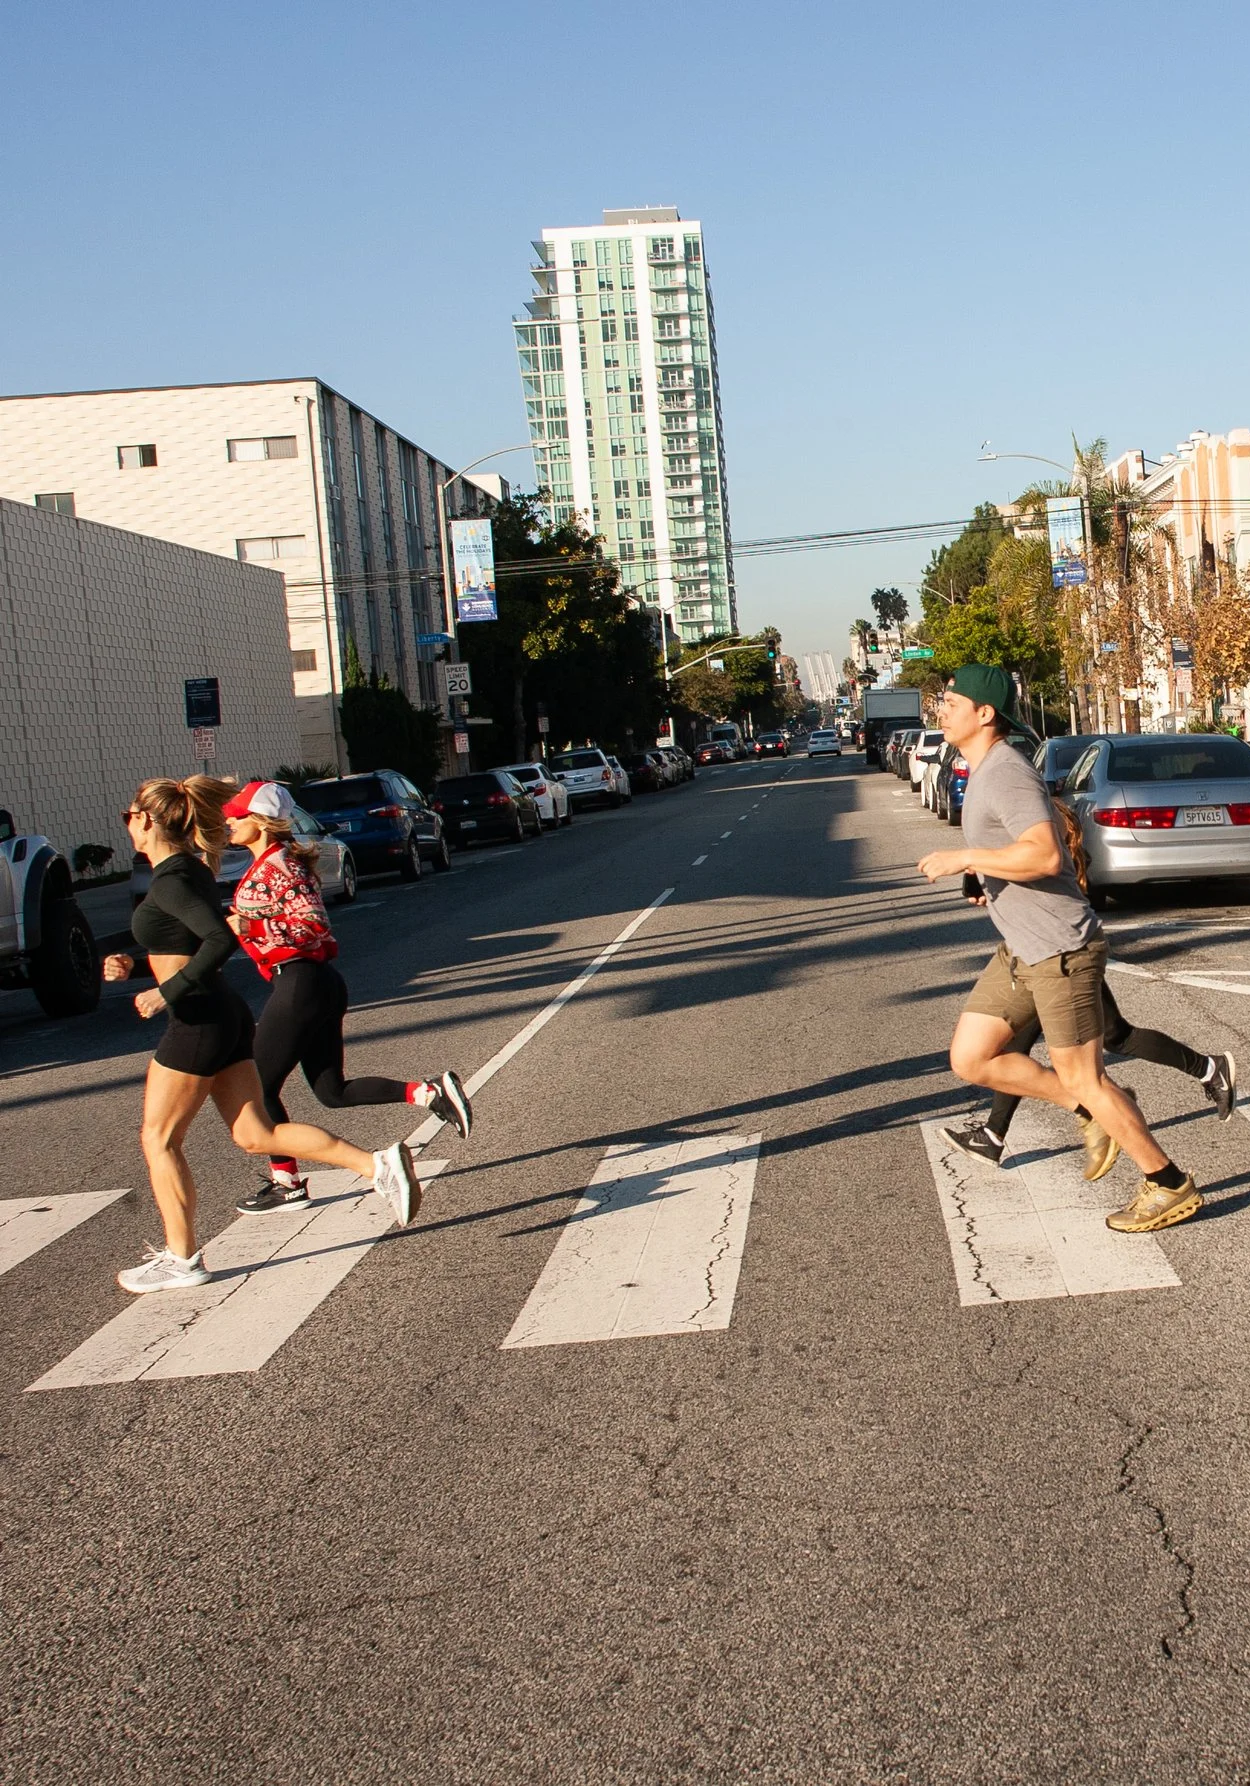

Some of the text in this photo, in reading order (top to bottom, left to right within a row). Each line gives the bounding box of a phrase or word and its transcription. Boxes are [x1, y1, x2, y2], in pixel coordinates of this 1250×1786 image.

[448, 680, 468, 691] 20
[1186, 811, 1221, 822] 5PTV615
[285, 1188, 305, 1200] HOKA
